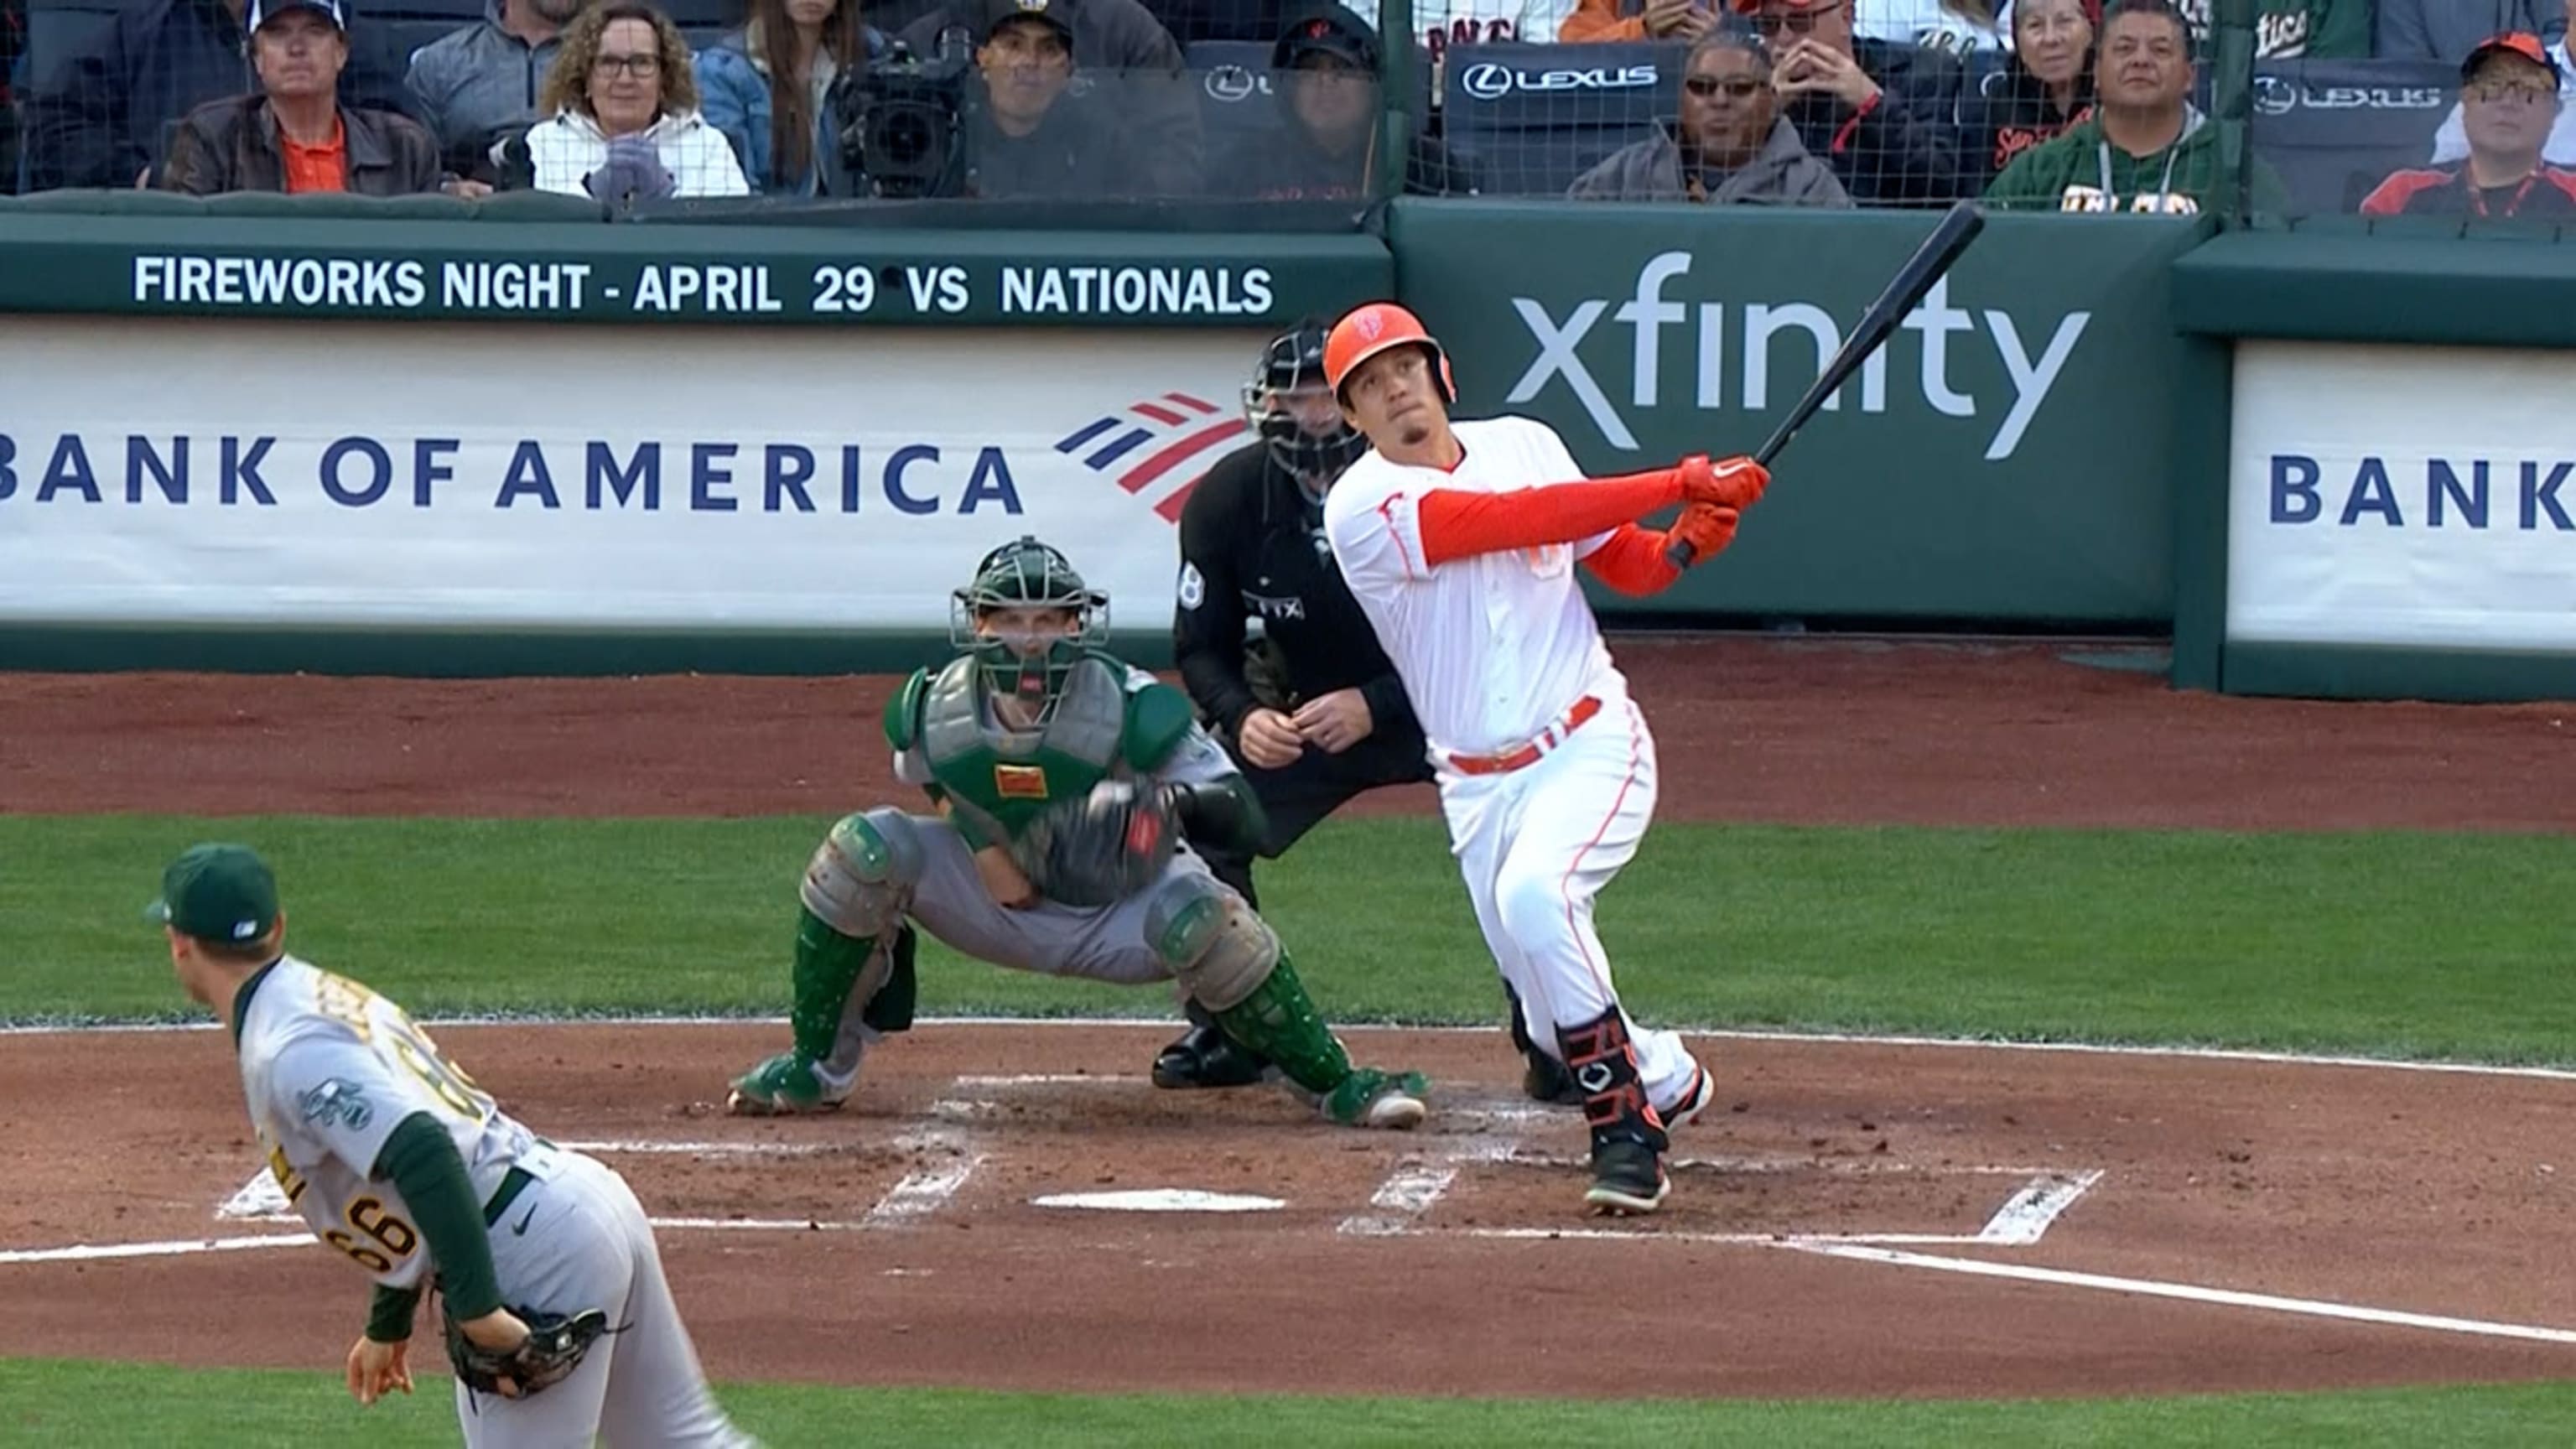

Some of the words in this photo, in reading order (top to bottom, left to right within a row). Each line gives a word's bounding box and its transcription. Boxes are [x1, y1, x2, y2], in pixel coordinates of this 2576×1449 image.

[1516, 65, 1658, 90] LEXUS
[2302, 87, 2441, 109] LEXUS
[134, 255, 426, 308] FIREWORKS
[443, 262, 590, 310] NIGHT
[632, 264, 782, 312] APRIL
[812, 265, 874, 312] 29
[906, 266, 969, 313] VS
[1002, 266, 1274, 314] NATIONALS
[1506, 252, 2091, 460] xfinity
[319, 436, 460, 507] OF
[495, 439, 1024, 516] AMERICA
[2269, 454, 2576, 531] BANK
[321, 1194, 417, 1274] 66
